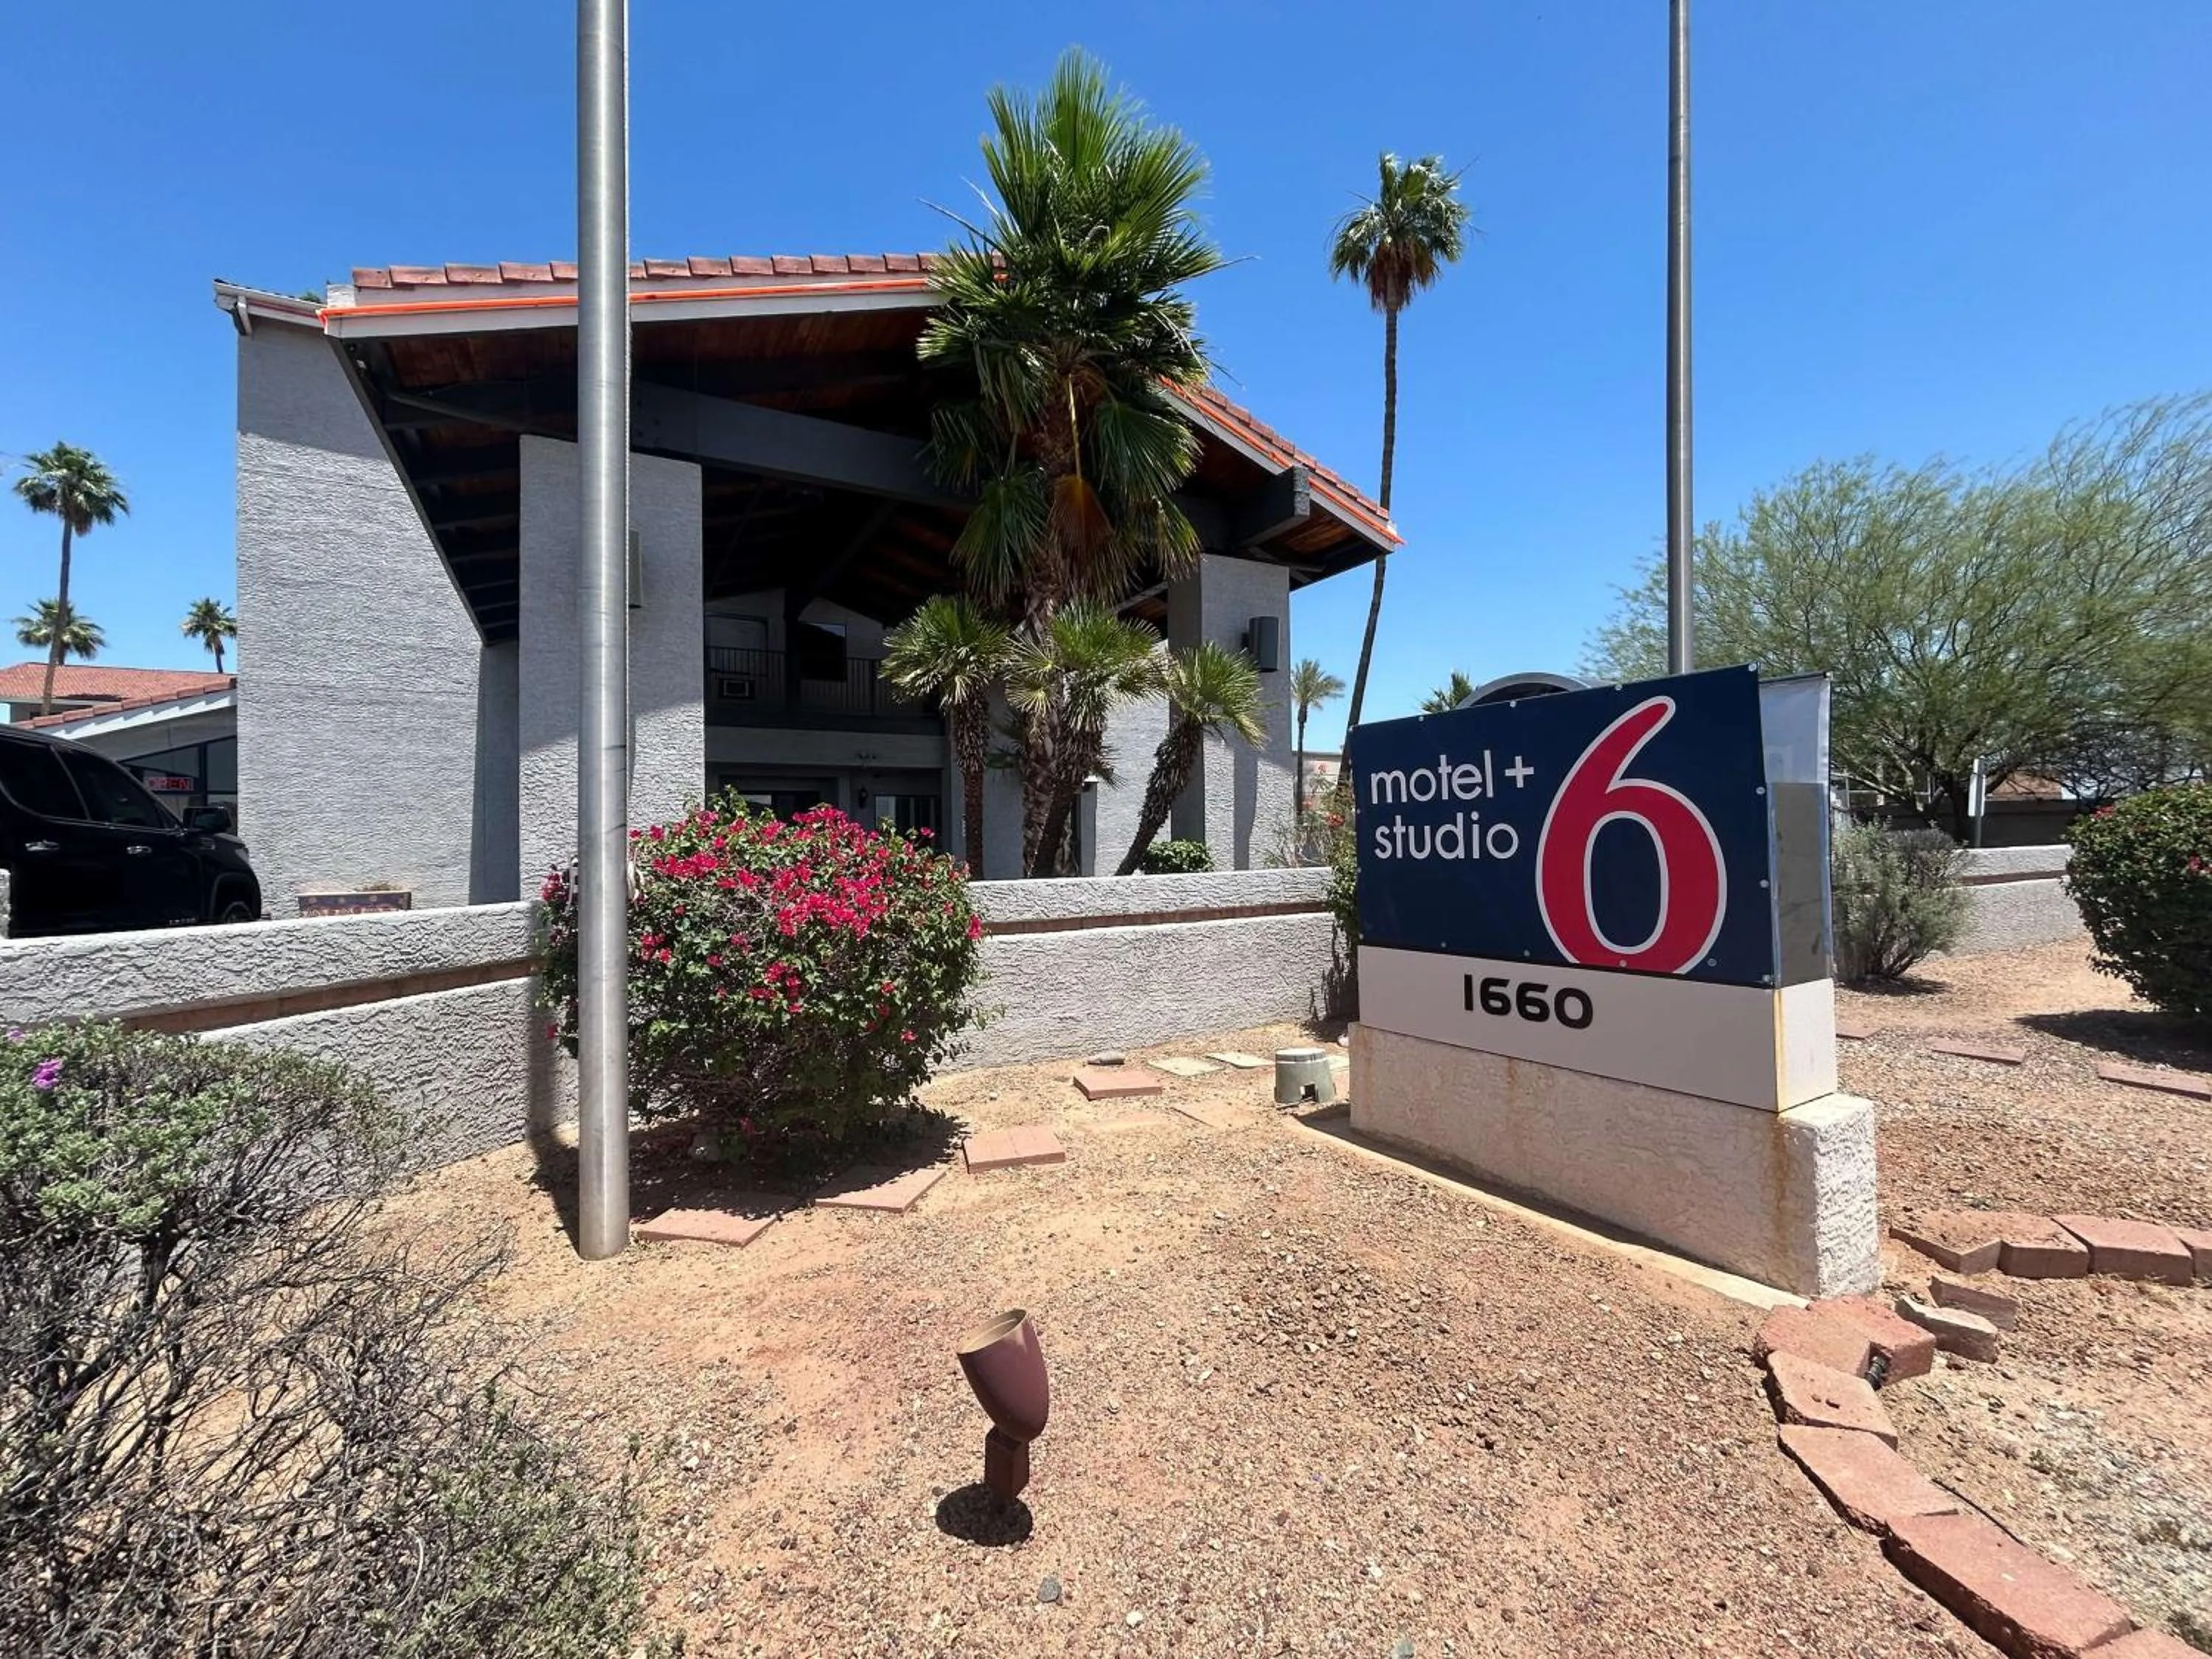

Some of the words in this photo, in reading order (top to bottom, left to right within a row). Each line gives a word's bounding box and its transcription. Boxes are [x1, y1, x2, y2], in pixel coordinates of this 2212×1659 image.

[1371, 749, 1493, 804] motel
[1505, 756, 1534, 788] +
[1374, 811, 1519, 860] studio
[1536, 695, 1727, 975] 6
[1464, 974, 1593, 1030] 1660
